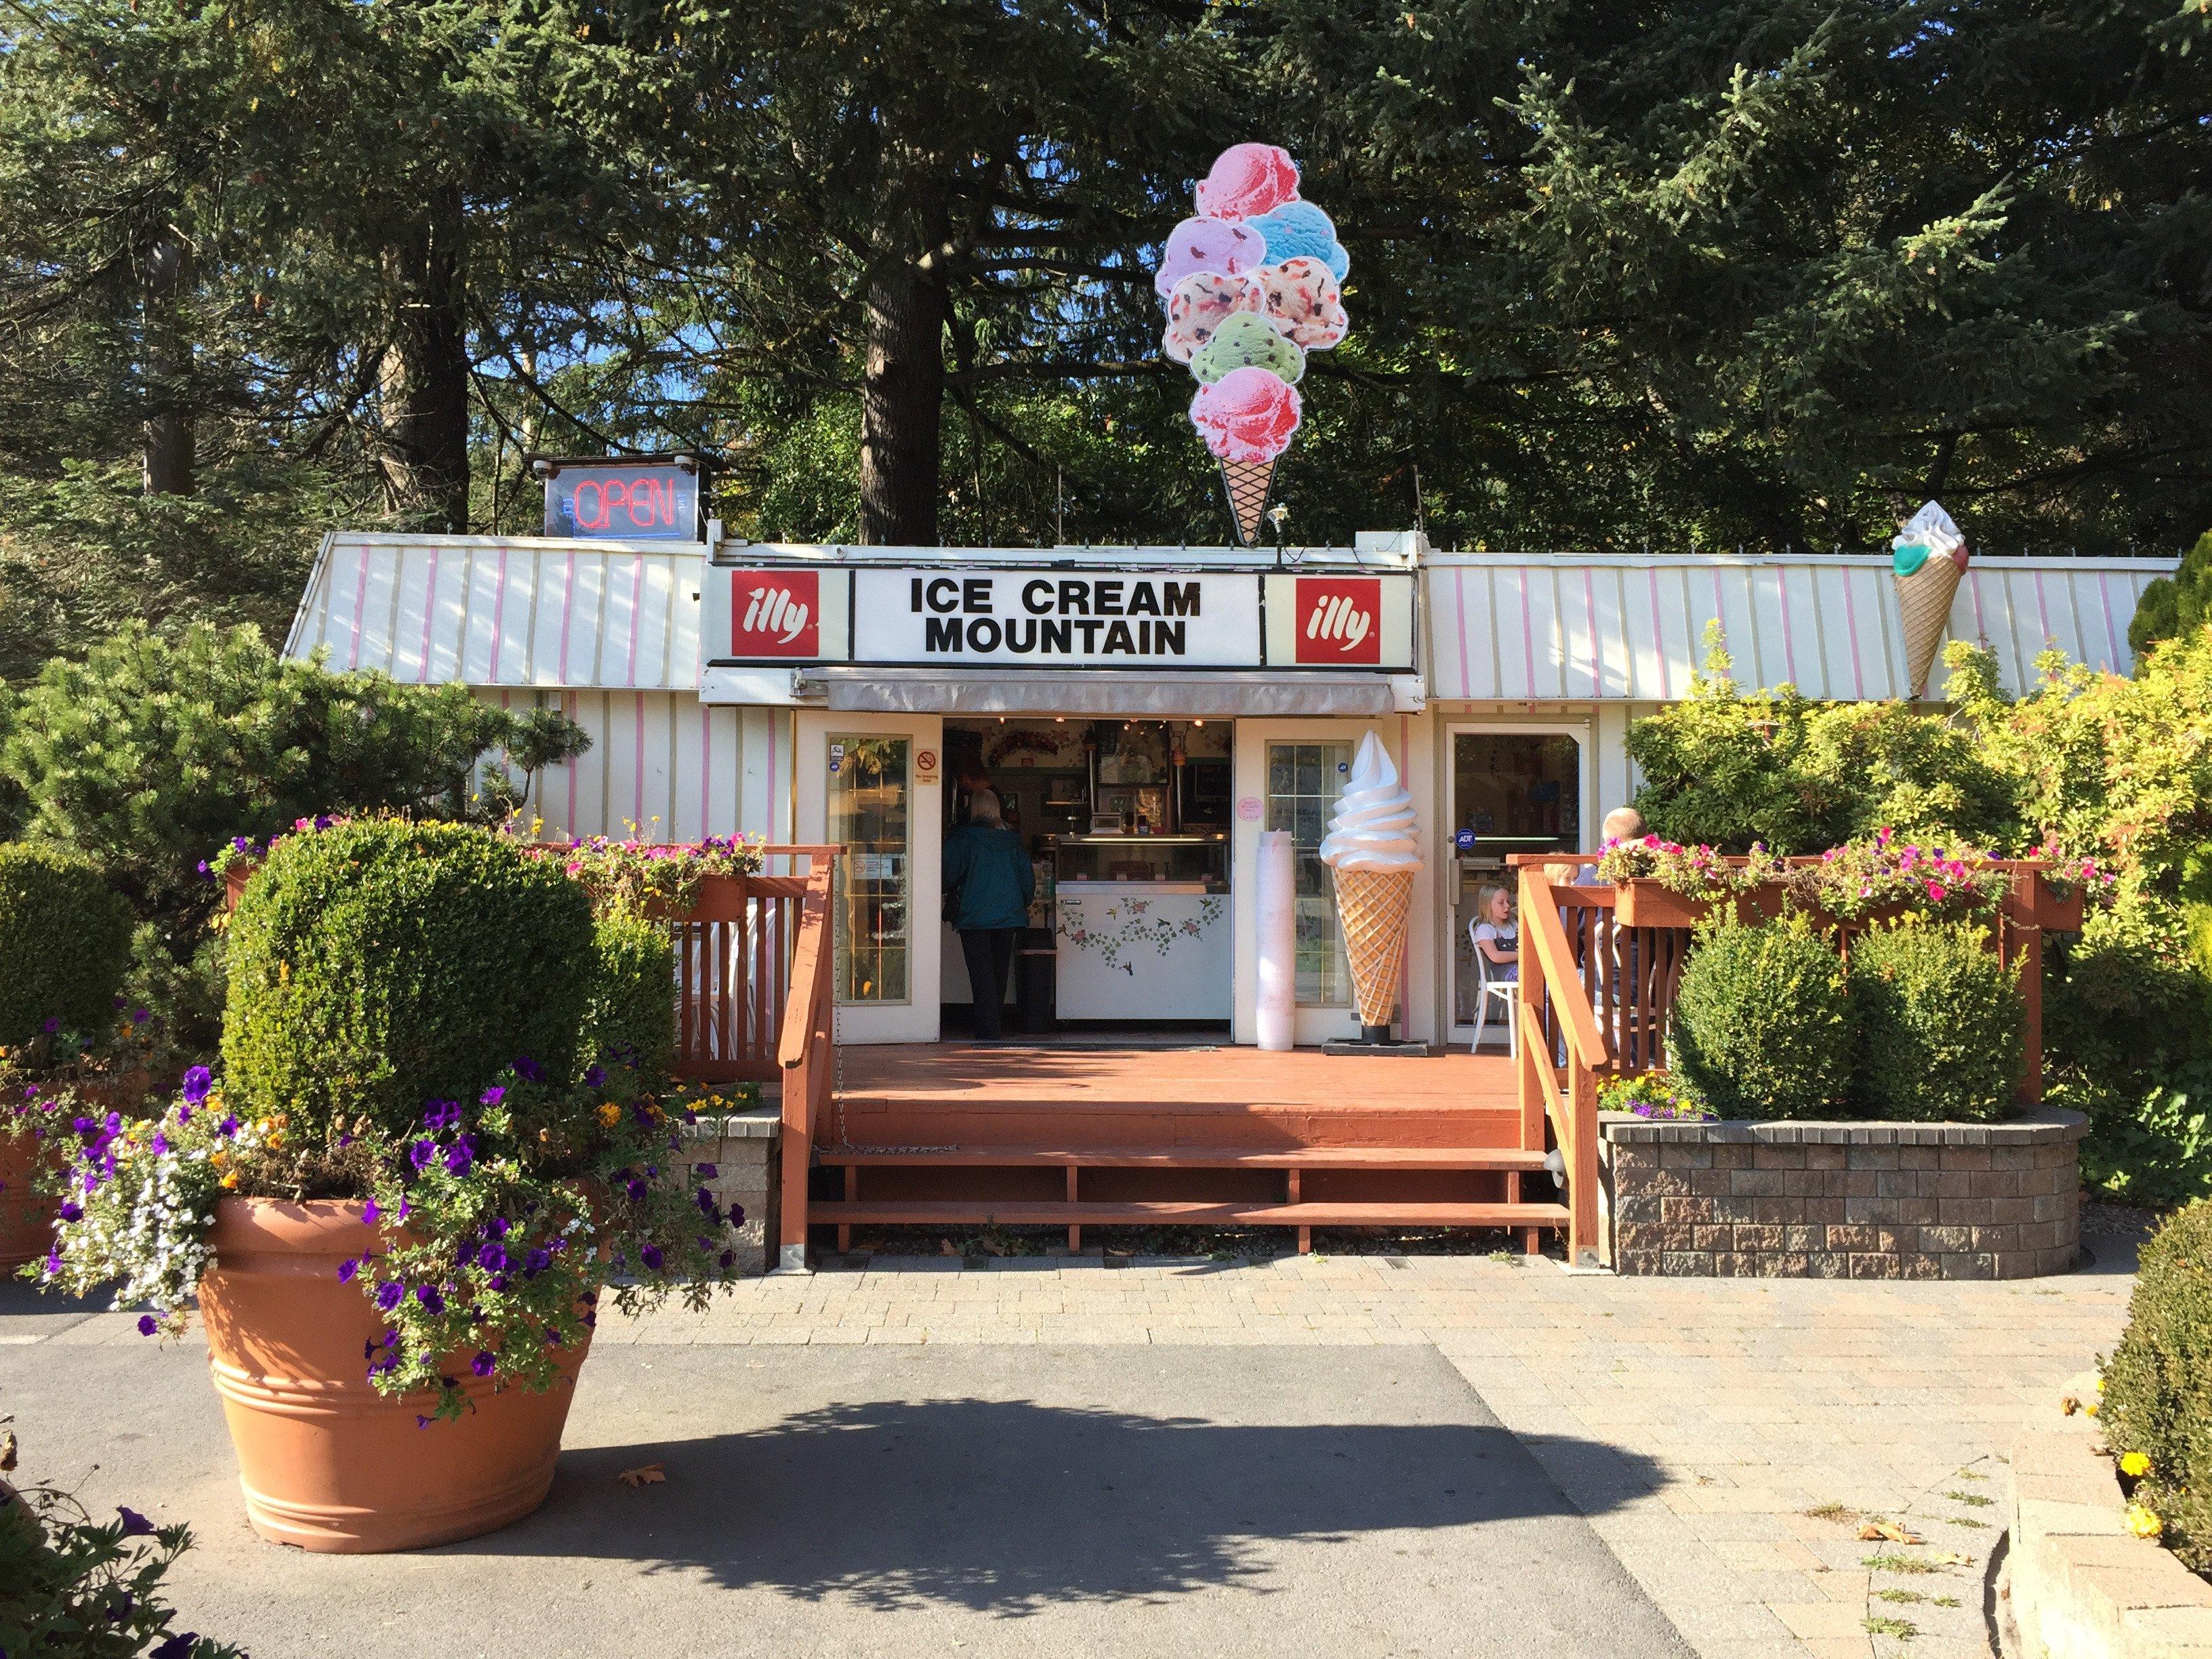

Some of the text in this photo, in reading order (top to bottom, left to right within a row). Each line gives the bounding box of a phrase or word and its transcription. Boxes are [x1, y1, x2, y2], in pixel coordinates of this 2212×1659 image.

[574, 478, 674, 529] OPEN
[743, 587, 808, 644] illy
[911, 577, 1201, 617] ICE CREAM
[925, 617, 1186, 655] MOUNTAIN
[1307, 595, 1370, 651] illy
